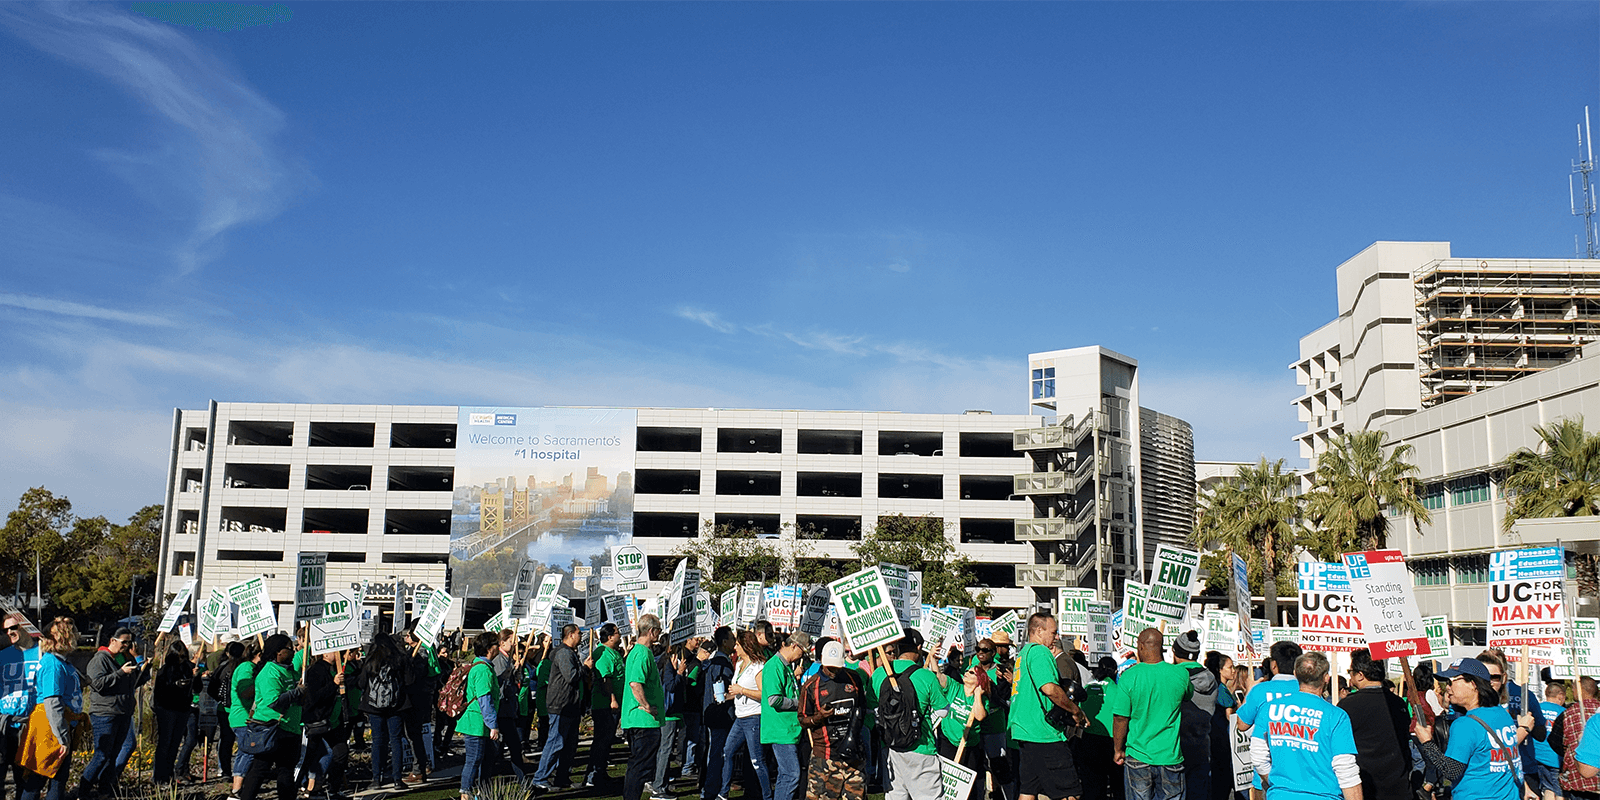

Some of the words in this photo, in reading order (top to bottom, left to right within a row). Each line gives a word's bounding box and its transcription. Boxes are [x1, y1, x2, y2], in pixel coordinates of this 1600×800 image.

[468, 434, 524, 446] Welcome
[528, 436, 540, 446] to
[544, 435, 621, 446] Sacramento's
[514, 449, 526, 459] #1
[530, 449, 580, 461] hospital
[617, 553, 642, 565] STOP
[1160, 550, 1184, 561] AFSCME
[1184, 555, 1198, 566] 3299
[1346, 556, 1365, 566] UP
[1491, 552, 1517, 567] UP
[1158, 562, 1192, 587] END
[1299, 562, 1327, 577] UP
[1350, 567, 1370, 578] TE
[1490, 565, 1517, 580] TE
[301, 567, 323, 587] END
[835, 580, 859, 594] AFSCME
[861, 573, 877, 584] 3299
[1299, 577, 1327, 590] TE
[351, 583, 434, 595] PARKNG
[540, 584, 556, 596] STOP
[1366, 583, 1403, 594] Standing
[1535, 581, 1561, 590] FOR
[232, 587, 263, 602] INEQUALITY
[1150, 584, 1189, 604] OUTSOURCING
[1343, 595, 1355, 603] FO
[1492, 582, 1532, 603] UC
[1534, 592, 1560, 601] THE
[241, 597, 259, 608] HURTS
[680, 596, 693, 614] ND
[697, 600, 706, 610] OP
[773, 599, 789, 607] UC
[811, 596, 827, 607] STOP
[841, 584, 882, 616] END
[1302, 593, 1341, 612] UC
[1368, 596, 1405, 608] Together
[241, 604, 262, 616] PATIENT
[324, 600, 348, 615] TOP
[723, 599, 733, 615] END
[772, 608, 798, 616] MANY
[1147, 600, 1186, 619] SOLIDARITY
[1343, 605, 1358, 613] TH
[1492, 604, 1560, 621] MANY
[246, 613, 261, 622] CARE
[316, 614, 350, 625] OUTSOURCING
[846, 605, 893, 634] OUTSOURCING
[1382, 610, 1395, 619] for
[930, 617, 954, 631] INEQUALITY
[1209, 619, 1233, 632] END
[1302, 614, 1362, 630] MANY
[1374, 623, 1402, 634] Better
[1404, 620, 1416, 631] UC
[853, 623, 898, 648] SOLIDARITY
[1168, 626, 1179, 634] CARE
[1425, 625, 1443, 638] ND
[315, 640, 327, 651] ON
[328, 634, 357, 648] STRIKE
[1386, 641, 1417, 654] Solidarity
[1556, 666, 1568, 676] ON
[1269, 704, 1300, 722] UC
[1300, 707, 1323, 718] FOR
[1299, 716, 1321, 727] THE
[1269, 722, 1318, 740] MANY
[1487, 726, 1512, 749] UC
[1271, 739, 1283, 747] NOT
[1285, 740, 1300, 749] THE
[1302, 744, 1318, 752] FEW
